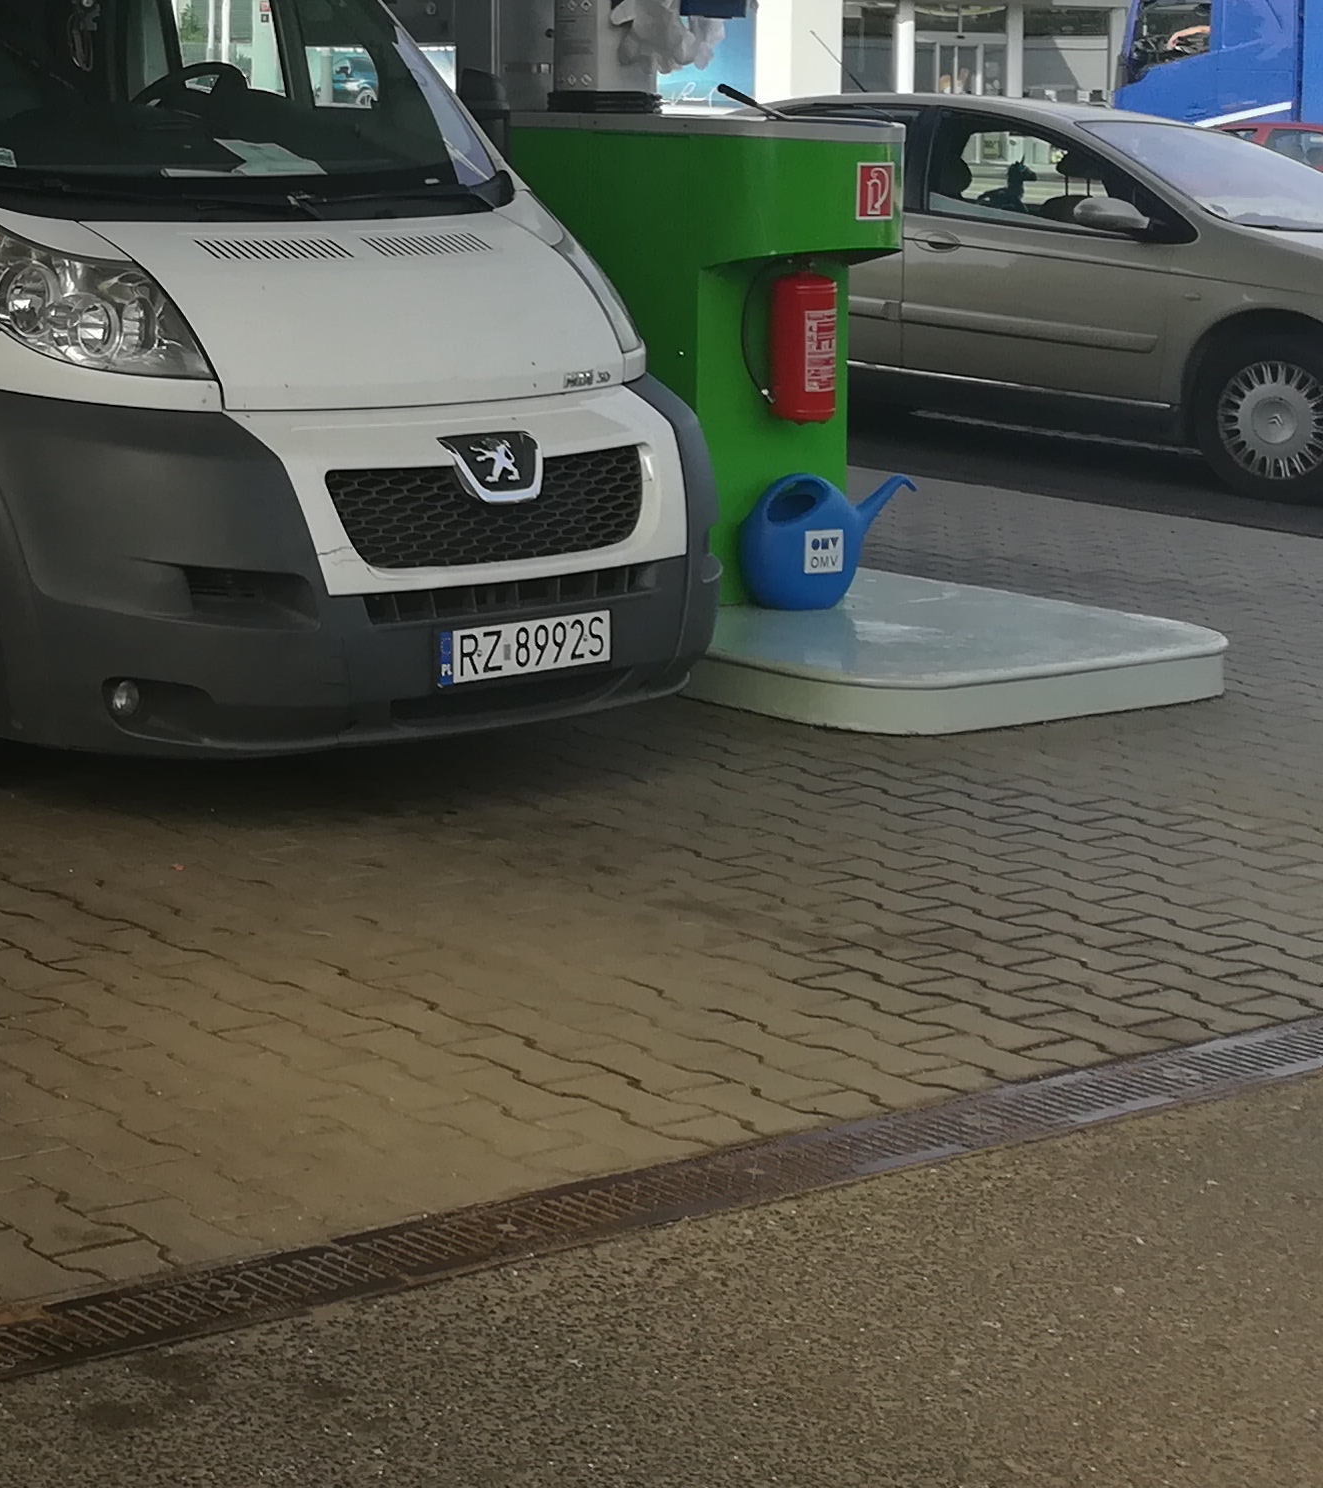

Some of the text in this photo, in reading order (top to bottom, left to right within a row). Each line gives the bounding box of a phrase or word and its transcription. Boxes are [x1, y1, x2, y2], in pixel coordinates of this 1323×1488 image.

[810, 555, 839, 568] OMV
[459, 616, 604, 677] RZ 8992S
[441, 663, 453, 677] PL
